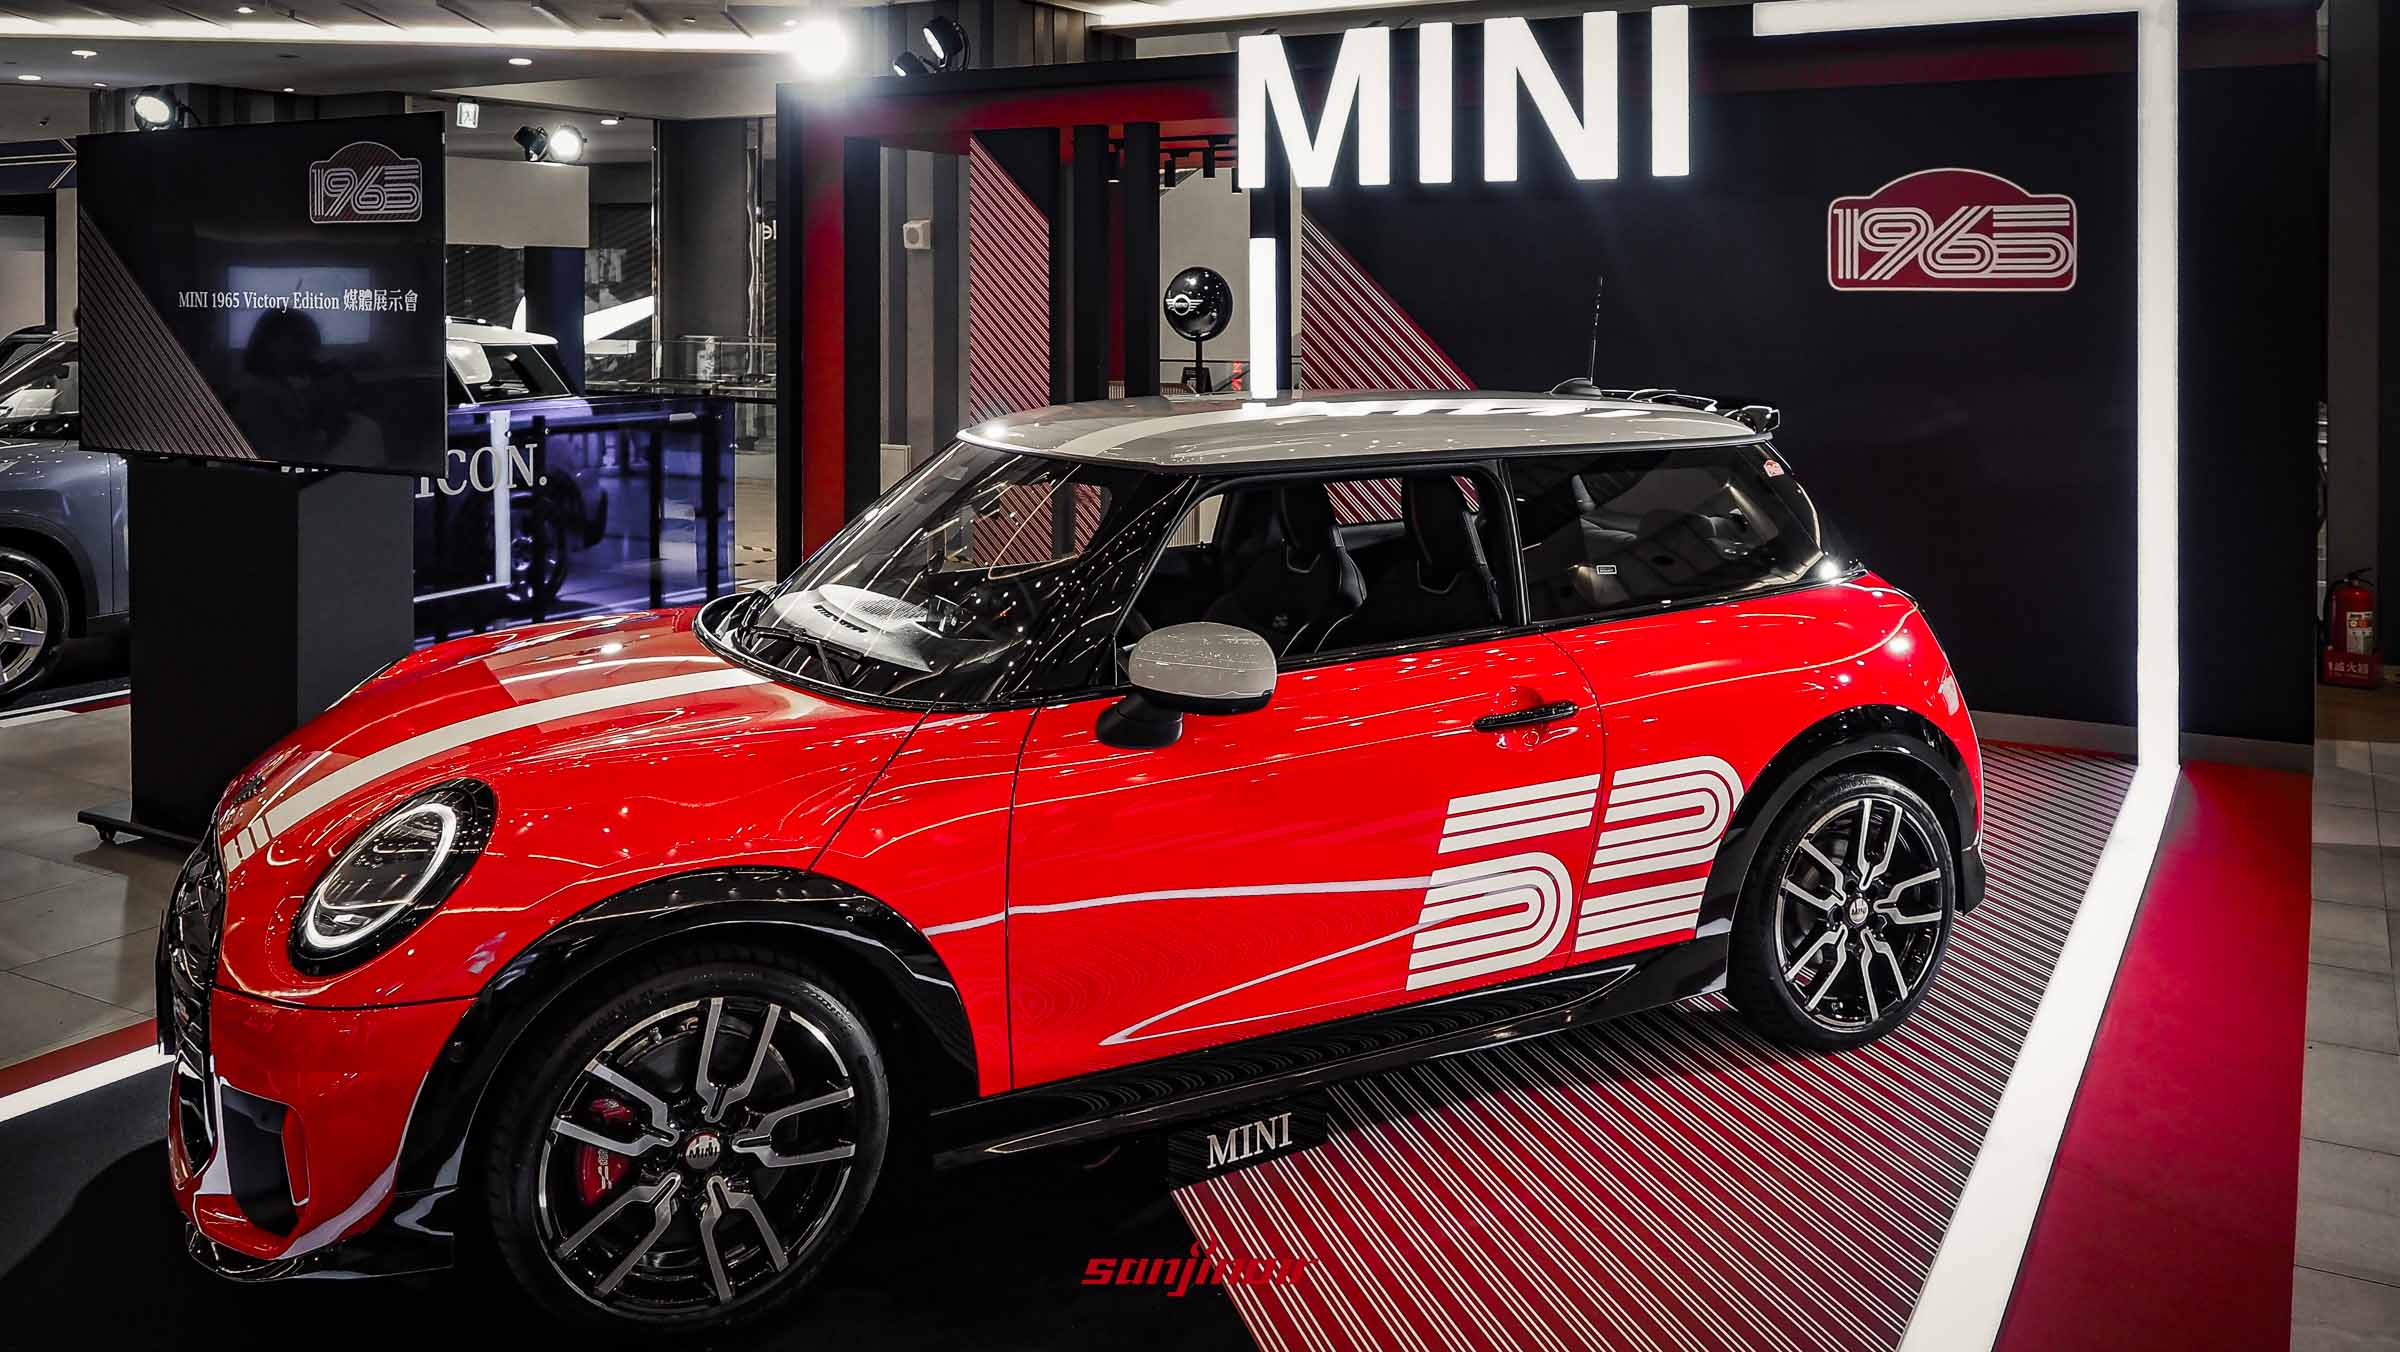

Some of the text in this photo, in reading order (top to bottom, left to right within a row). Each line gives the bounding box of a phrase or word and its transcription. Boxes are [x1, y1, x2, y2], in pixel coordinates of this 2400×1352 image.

[1238, 4, 1690, 189] MINI
[311, 164, 421, 217] 1965
[1833, 204, 2075, 280] 1965
[178, 288, 419, 313] MINI 1965 Victory Edition 媒體展示會
[1405, 754, 1746, 992] 52
[1206, 1112, 1293, 1169] MINI
